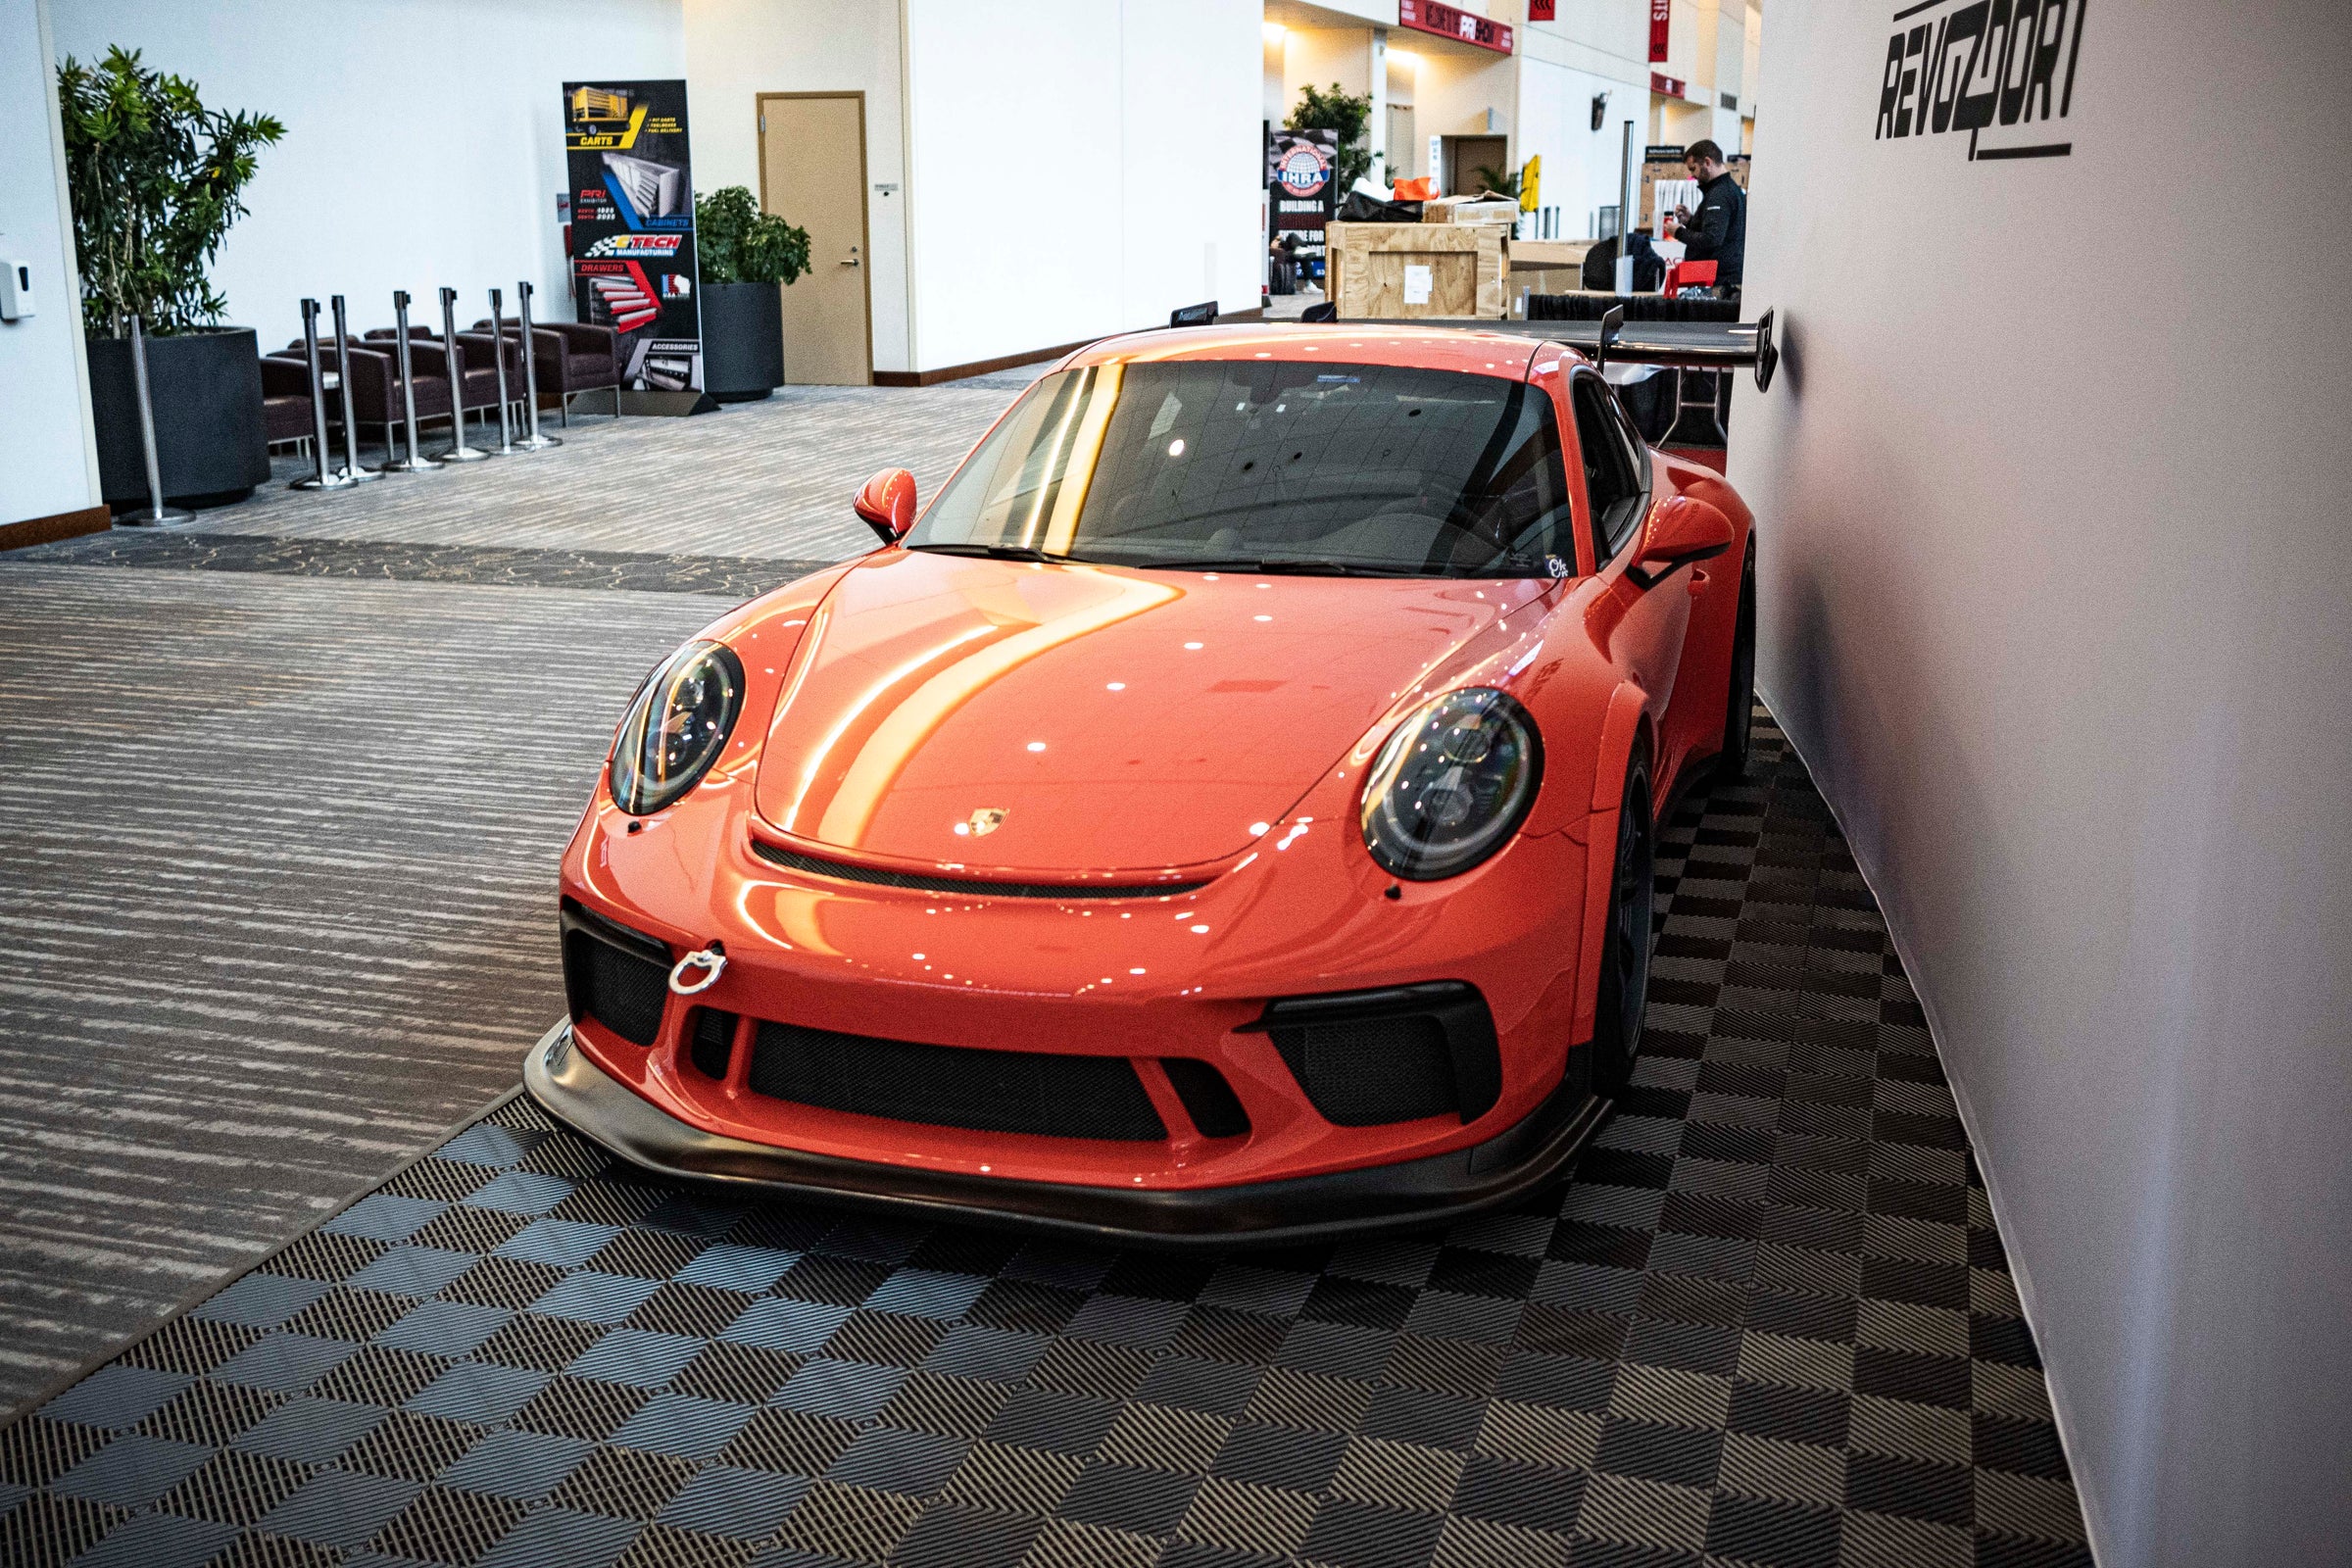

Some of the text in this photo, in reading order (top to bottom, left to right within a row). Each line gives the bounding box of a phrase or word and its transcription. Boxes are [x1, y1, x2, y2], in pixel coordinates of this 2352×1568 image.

[580, 136, 613, 146] CARTS
[1283, 172, 1323, 183] IHRA
[1280, 200, 1324, 213] BUILDING A
[1309, 230, 1324, 241] FOR
